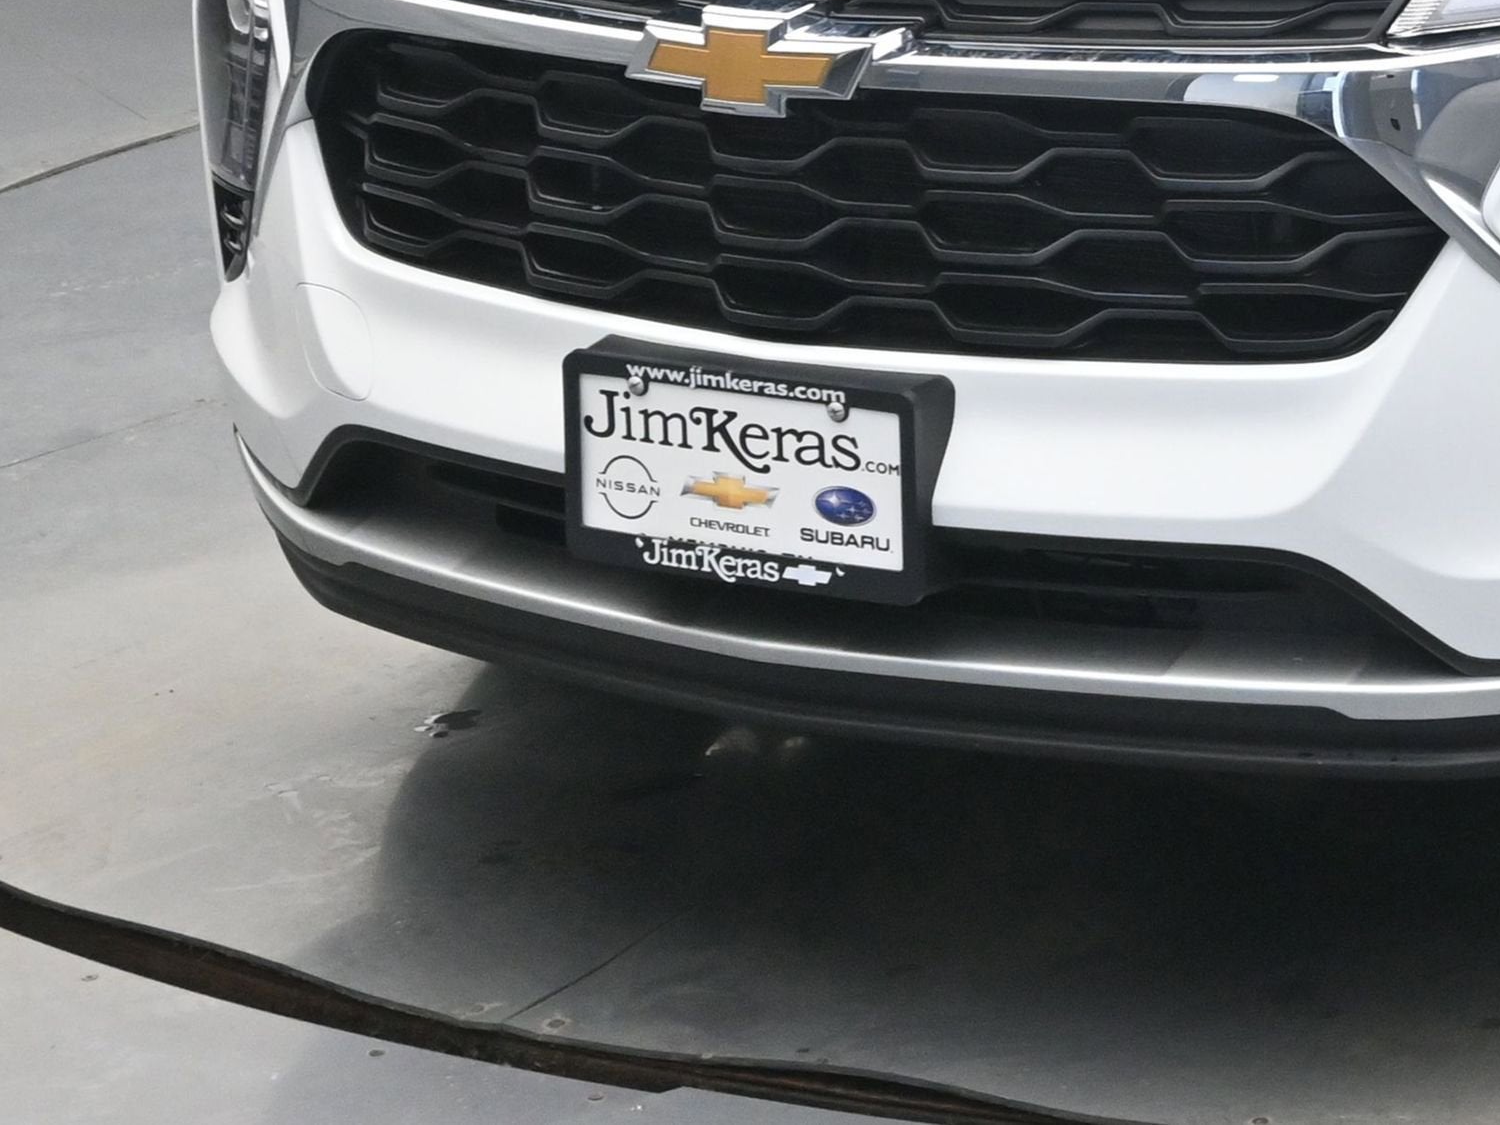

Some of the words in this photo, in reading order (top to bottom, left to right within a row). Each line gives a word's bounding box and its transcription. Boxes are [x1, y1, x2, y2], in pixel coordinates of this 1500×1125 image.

[626, 363, 846, 403] www.jimkeras.com
[596, 477, 661, 498] NISSAN
[689, 516, 770, 537] CHEVROLET
[799, 527, 891, 553] SUBARU
